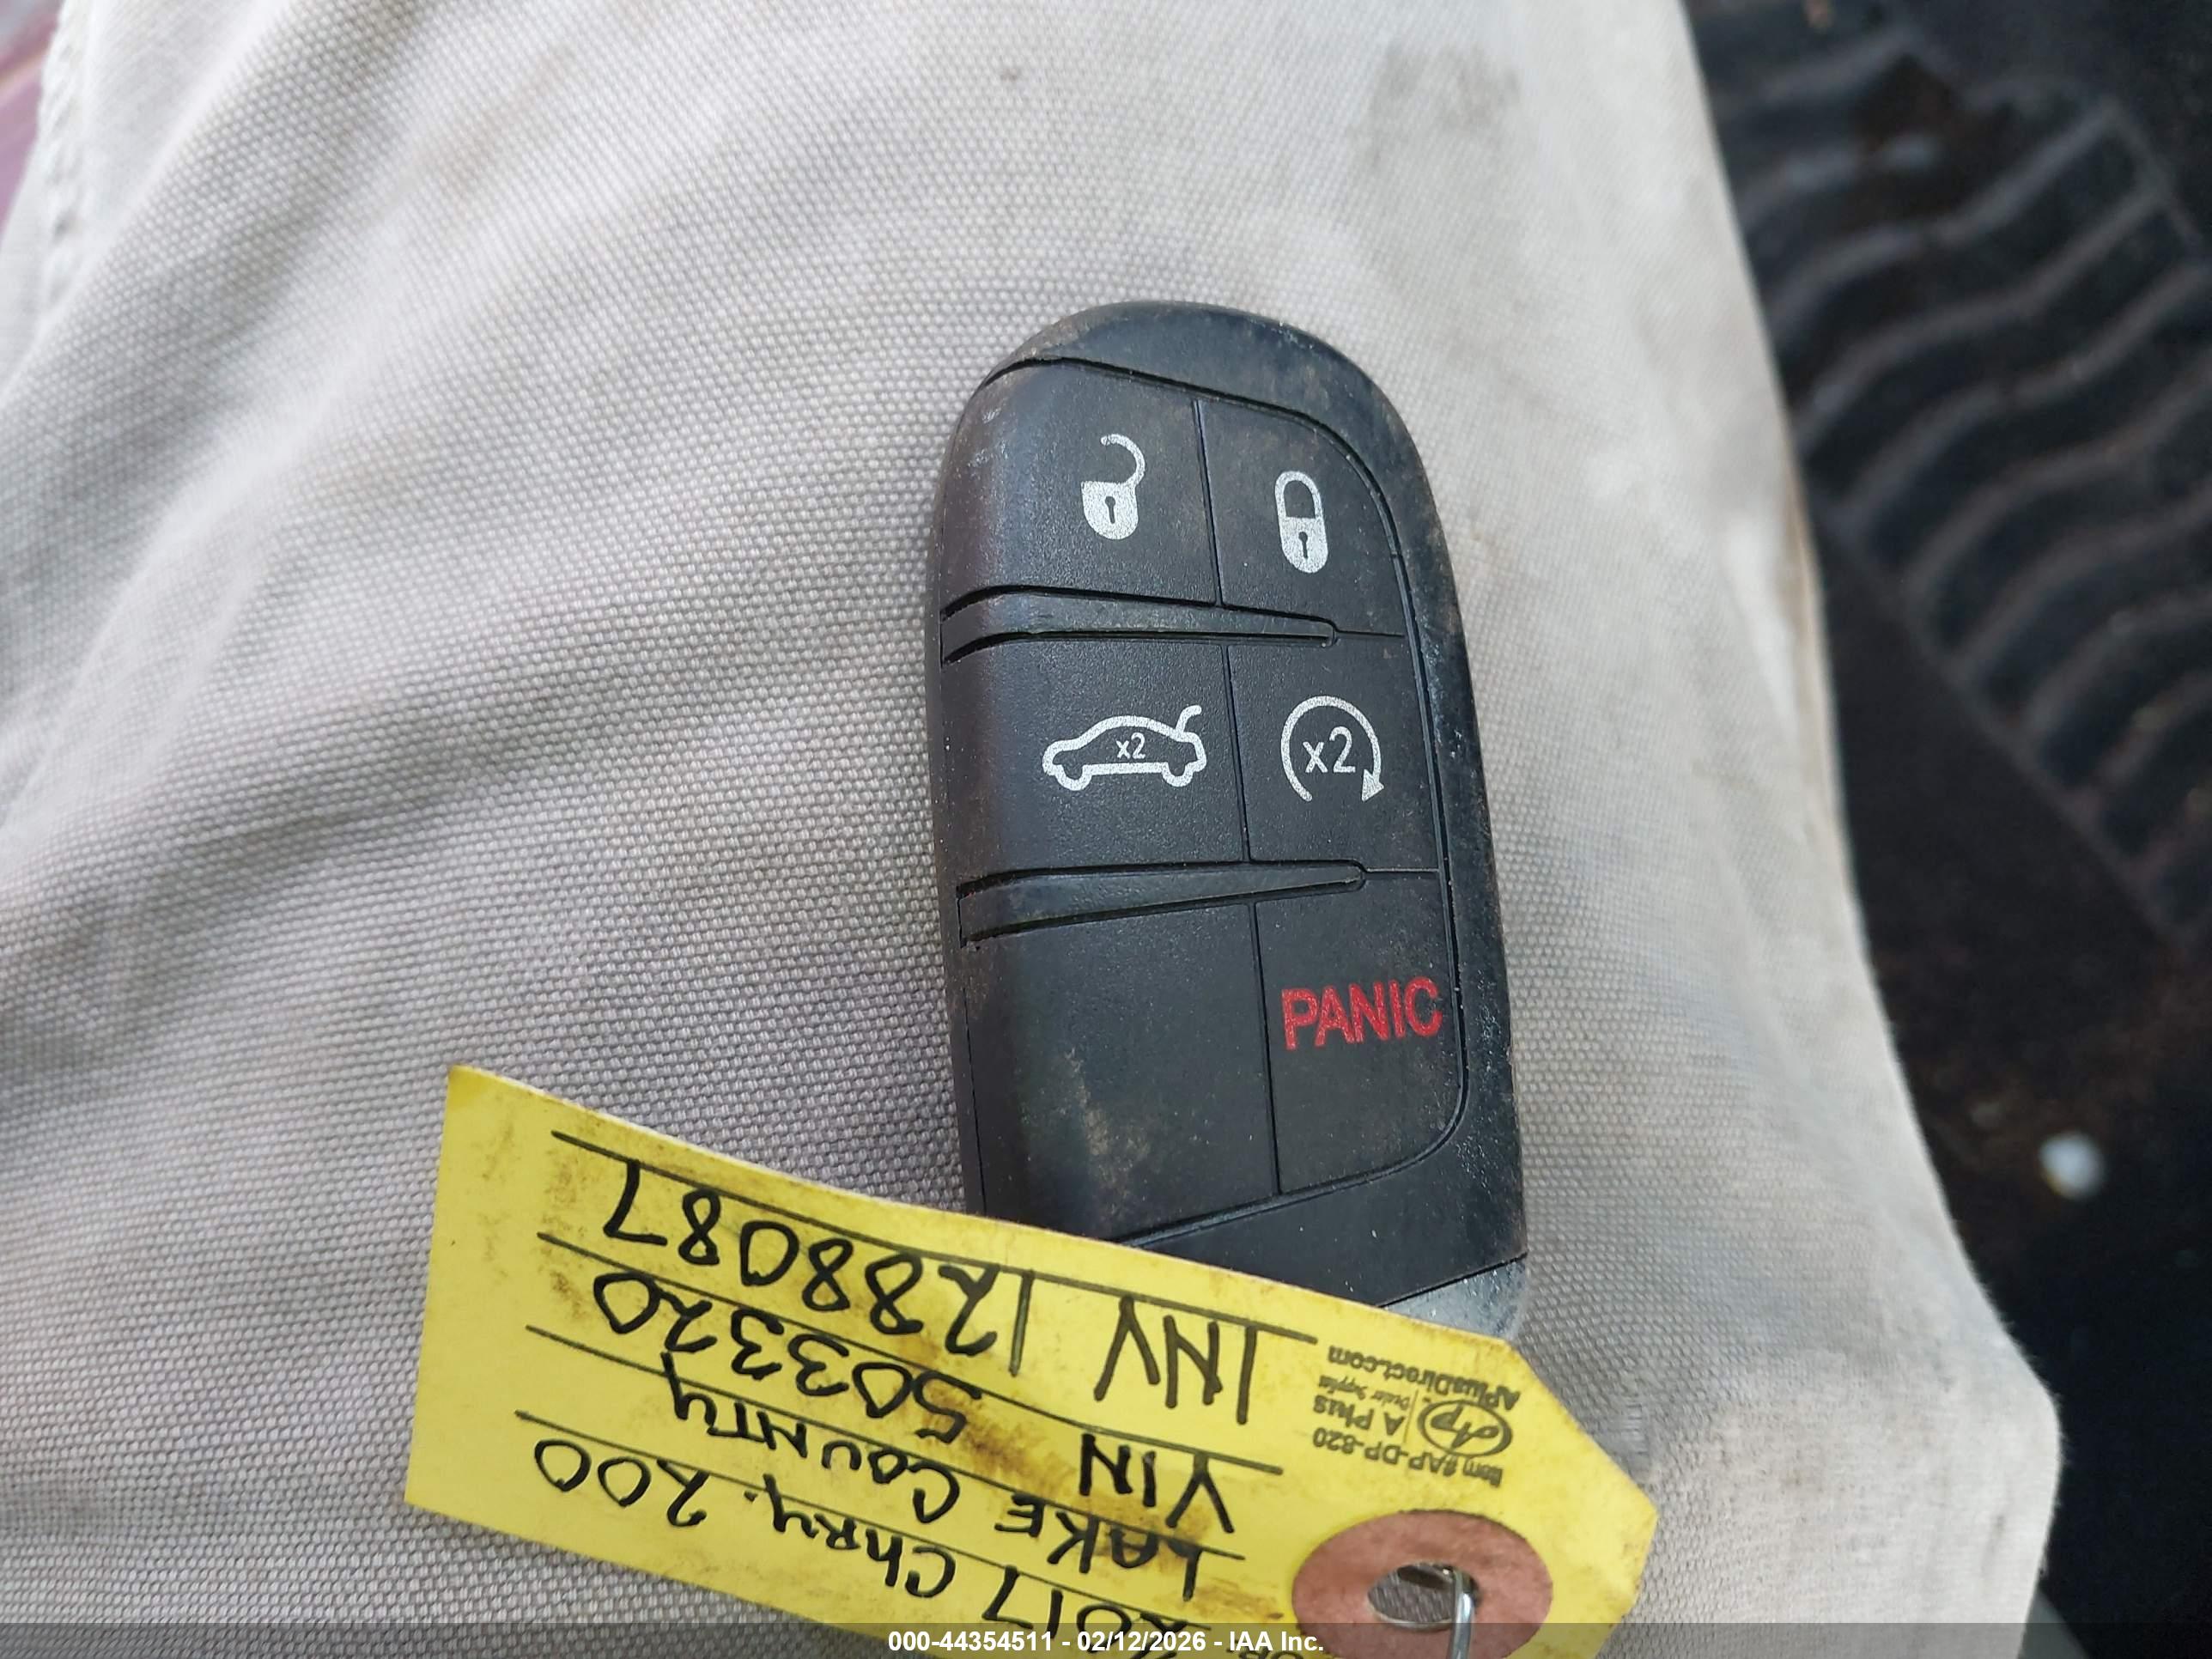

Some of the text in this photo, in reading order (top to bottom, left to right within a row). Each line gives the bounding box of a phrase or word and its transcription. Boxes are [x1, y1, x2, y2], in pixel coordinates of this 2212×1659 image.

[1116, 732, 1146, 760] x2
[1303, 726, 1356, 774] x2
[1281, 977, 1443, 1050] PANIC
[602, 1161, 1258, 1425] INV 1288087
[592, 1271, 1233, 1534] VIN 503320
[1328, 1346, 1521, 1411] APlusDirect.com
[1313, 1395, 1406, 1437] A Plus
[534, 1439, 713, 1528] 200
[660, 1352, 1204, 1602] LAKE COUNTY
[1312, 1427, 1458, 1477] #AP-DP-820
